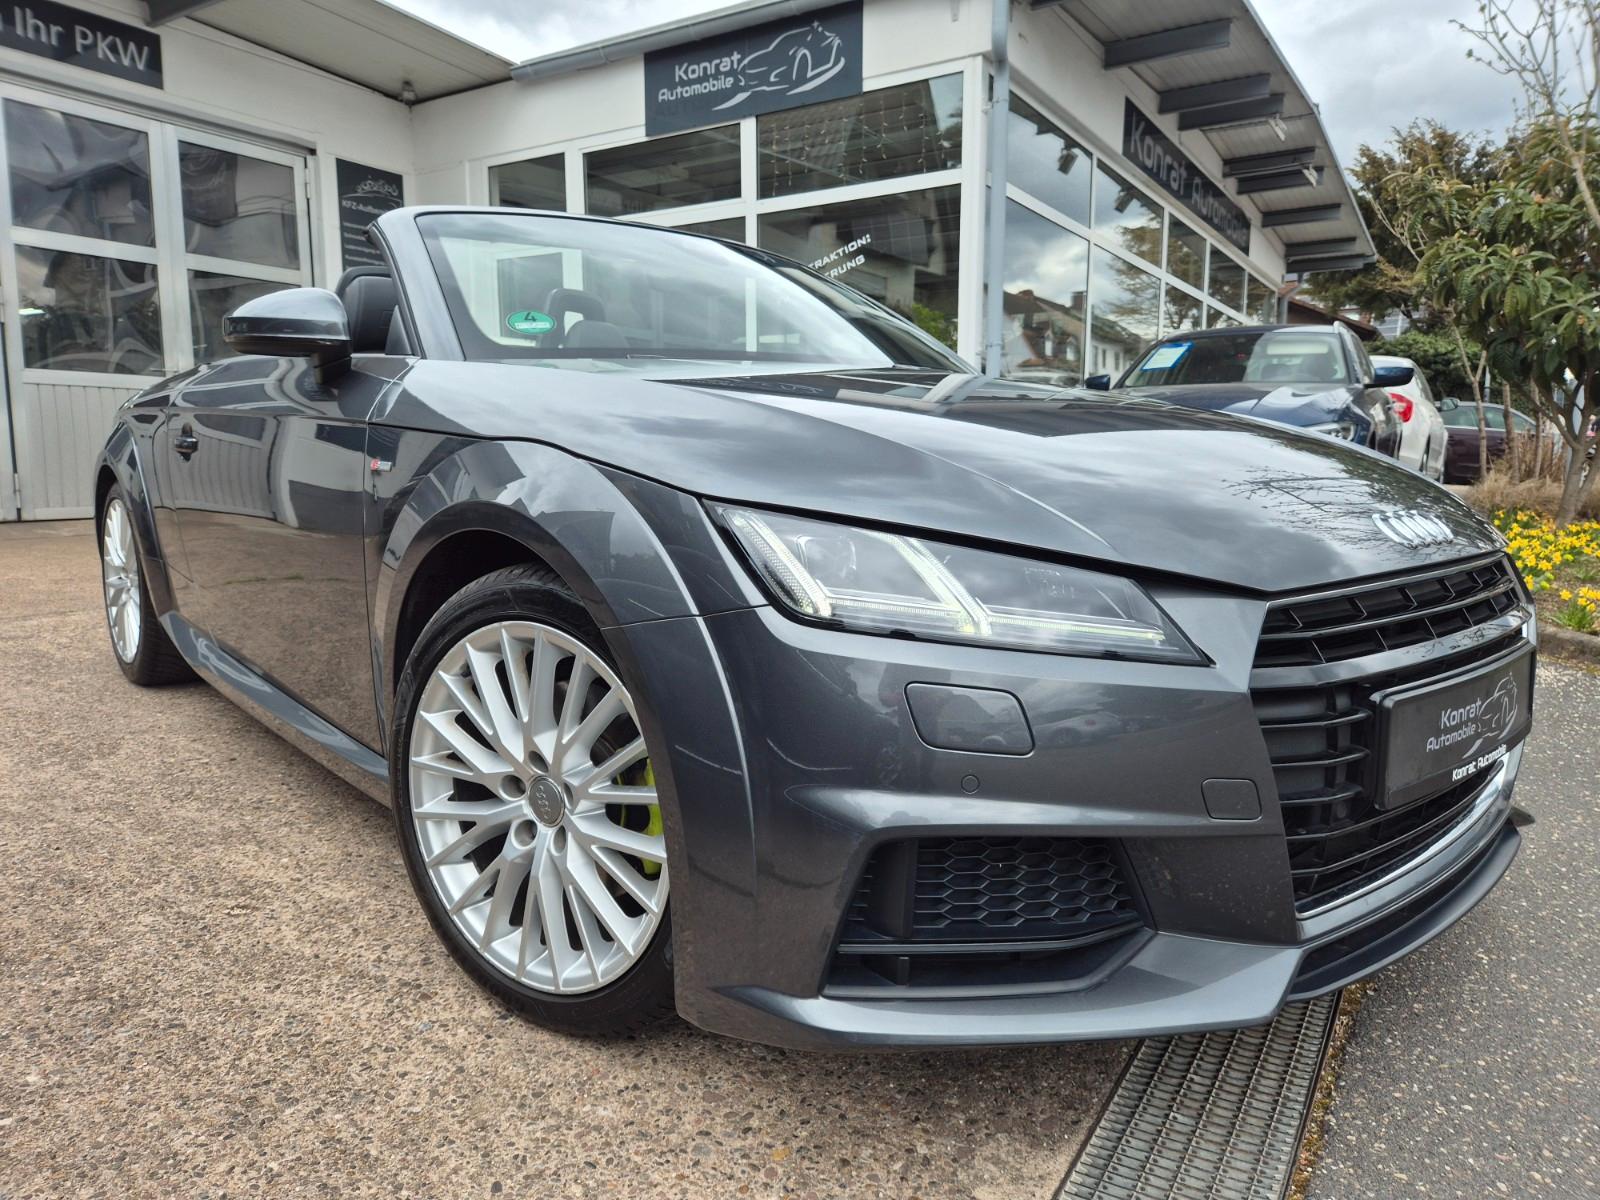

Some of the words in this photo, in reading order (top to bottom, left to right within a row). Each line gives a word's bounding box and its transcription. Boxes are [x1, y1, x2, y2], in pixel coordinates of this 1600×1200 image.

[13, 5, 64, 47] Ihr
[74, 24, 149, 71] PKW
[674, 51, 742, 82] Konrat
[658, 74, 734, 103] Automobile
[1130, 111, 1188, 196] Konrat
[1440, 697, 1482, 730] Konrat
[1426, 722, 1476, 753] Automobile
[1451, 760, 1477, 782] Konrat
